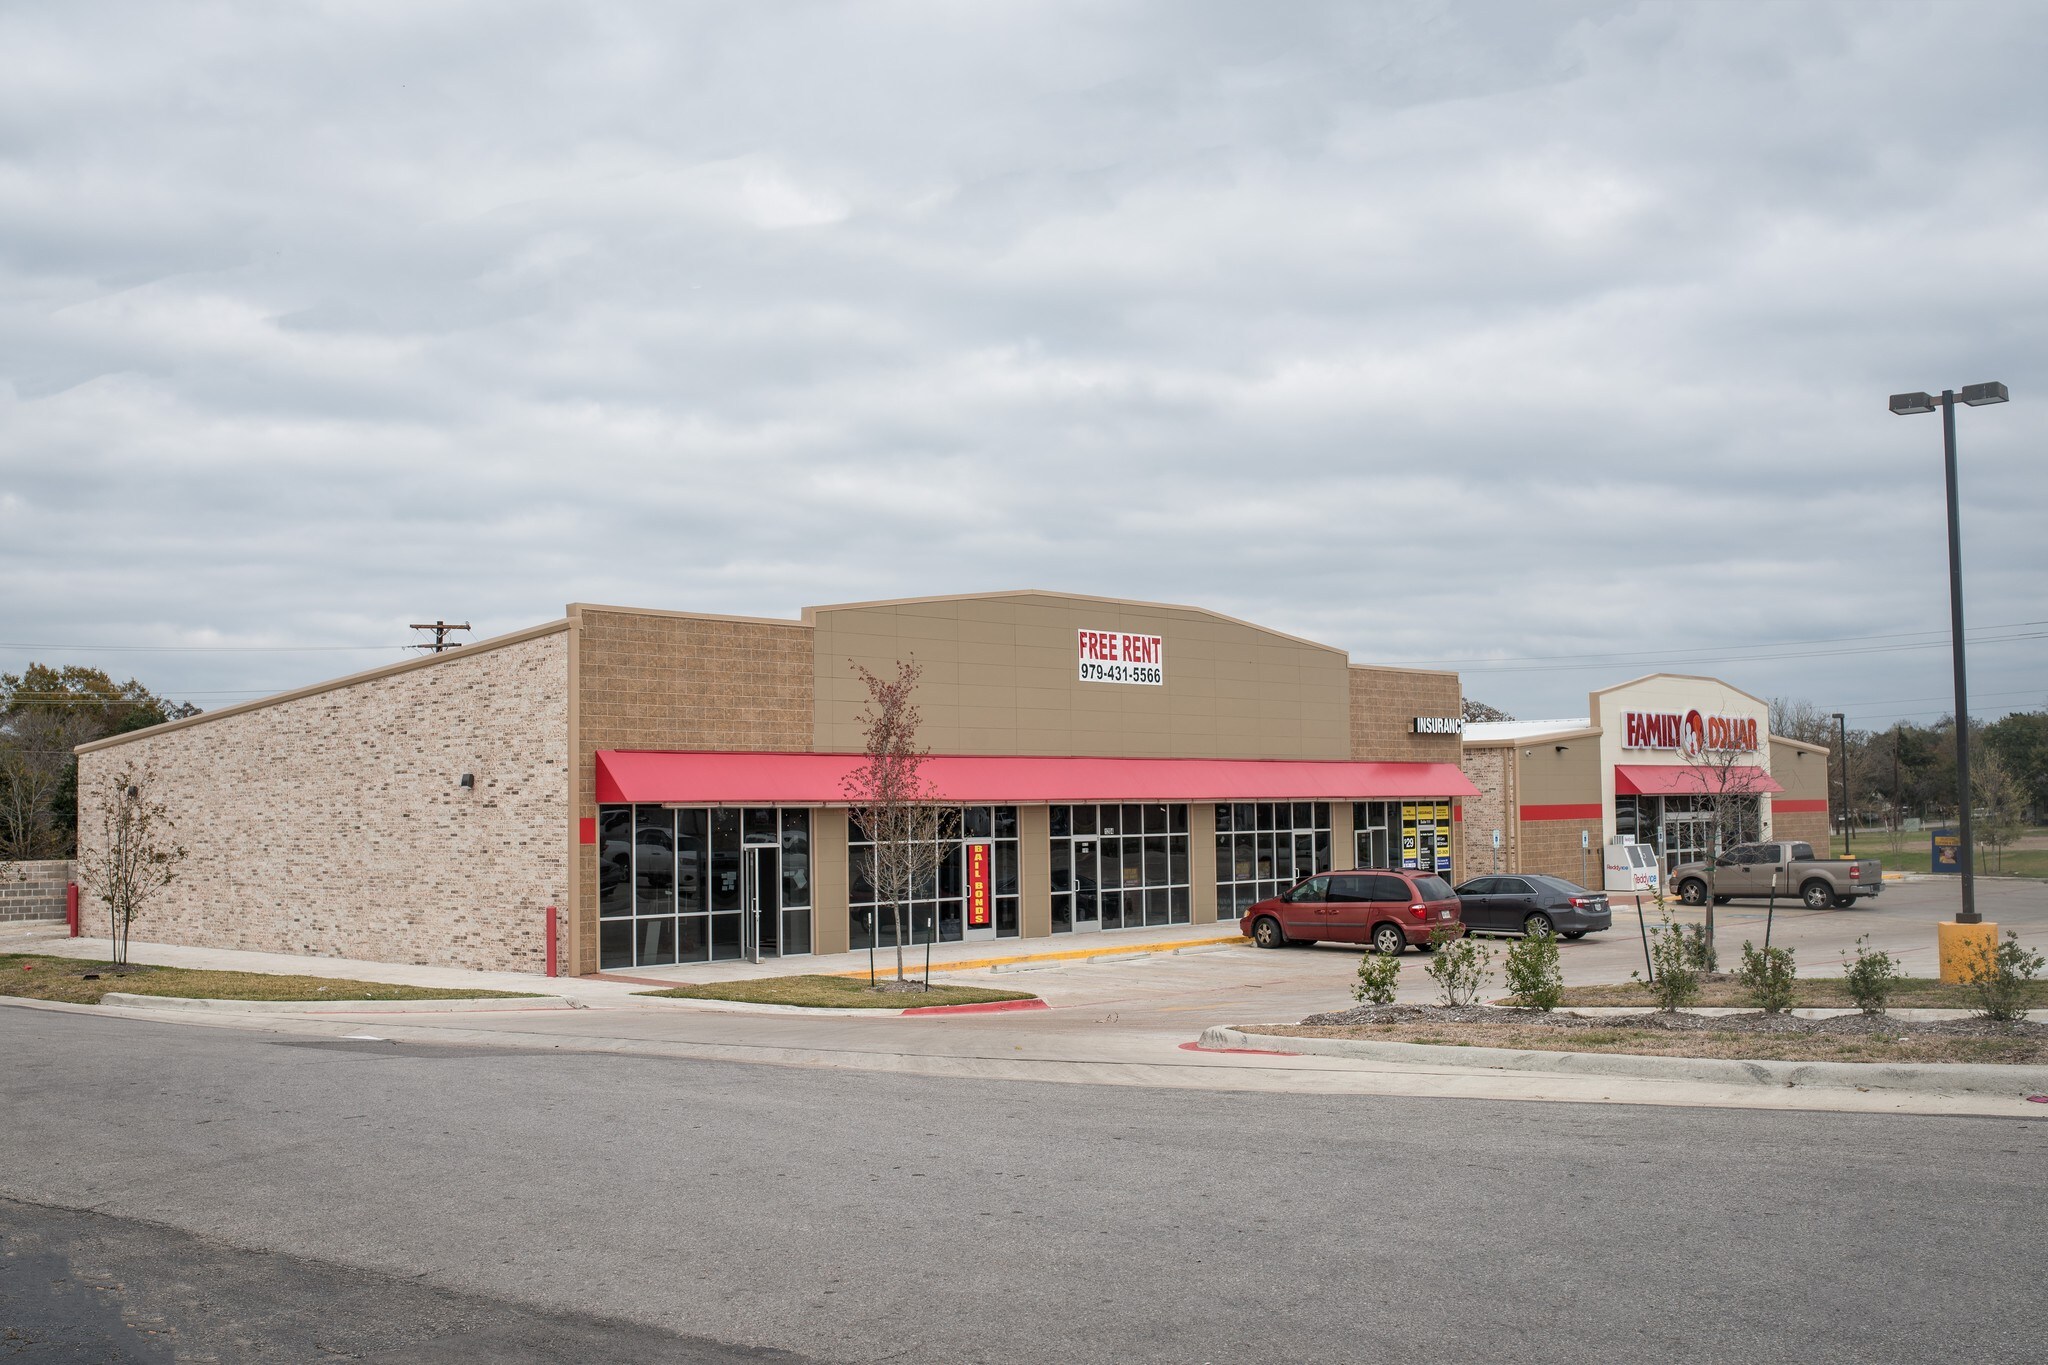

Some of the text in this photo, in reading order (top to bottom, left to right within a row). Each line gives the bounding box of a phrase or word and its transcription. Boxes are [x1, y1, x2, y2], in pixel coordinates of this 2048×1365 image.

[1080, 631, 1161, 664] FREE RENT
[1081, 663, 1161, 683] 979-431-5566
[1417, 717, 1466, 735] INSURANCE
[1626, 713, 1758, 750] FAMILY DOLLAR
[974, 845, 984, 923] BAIL BONDS
